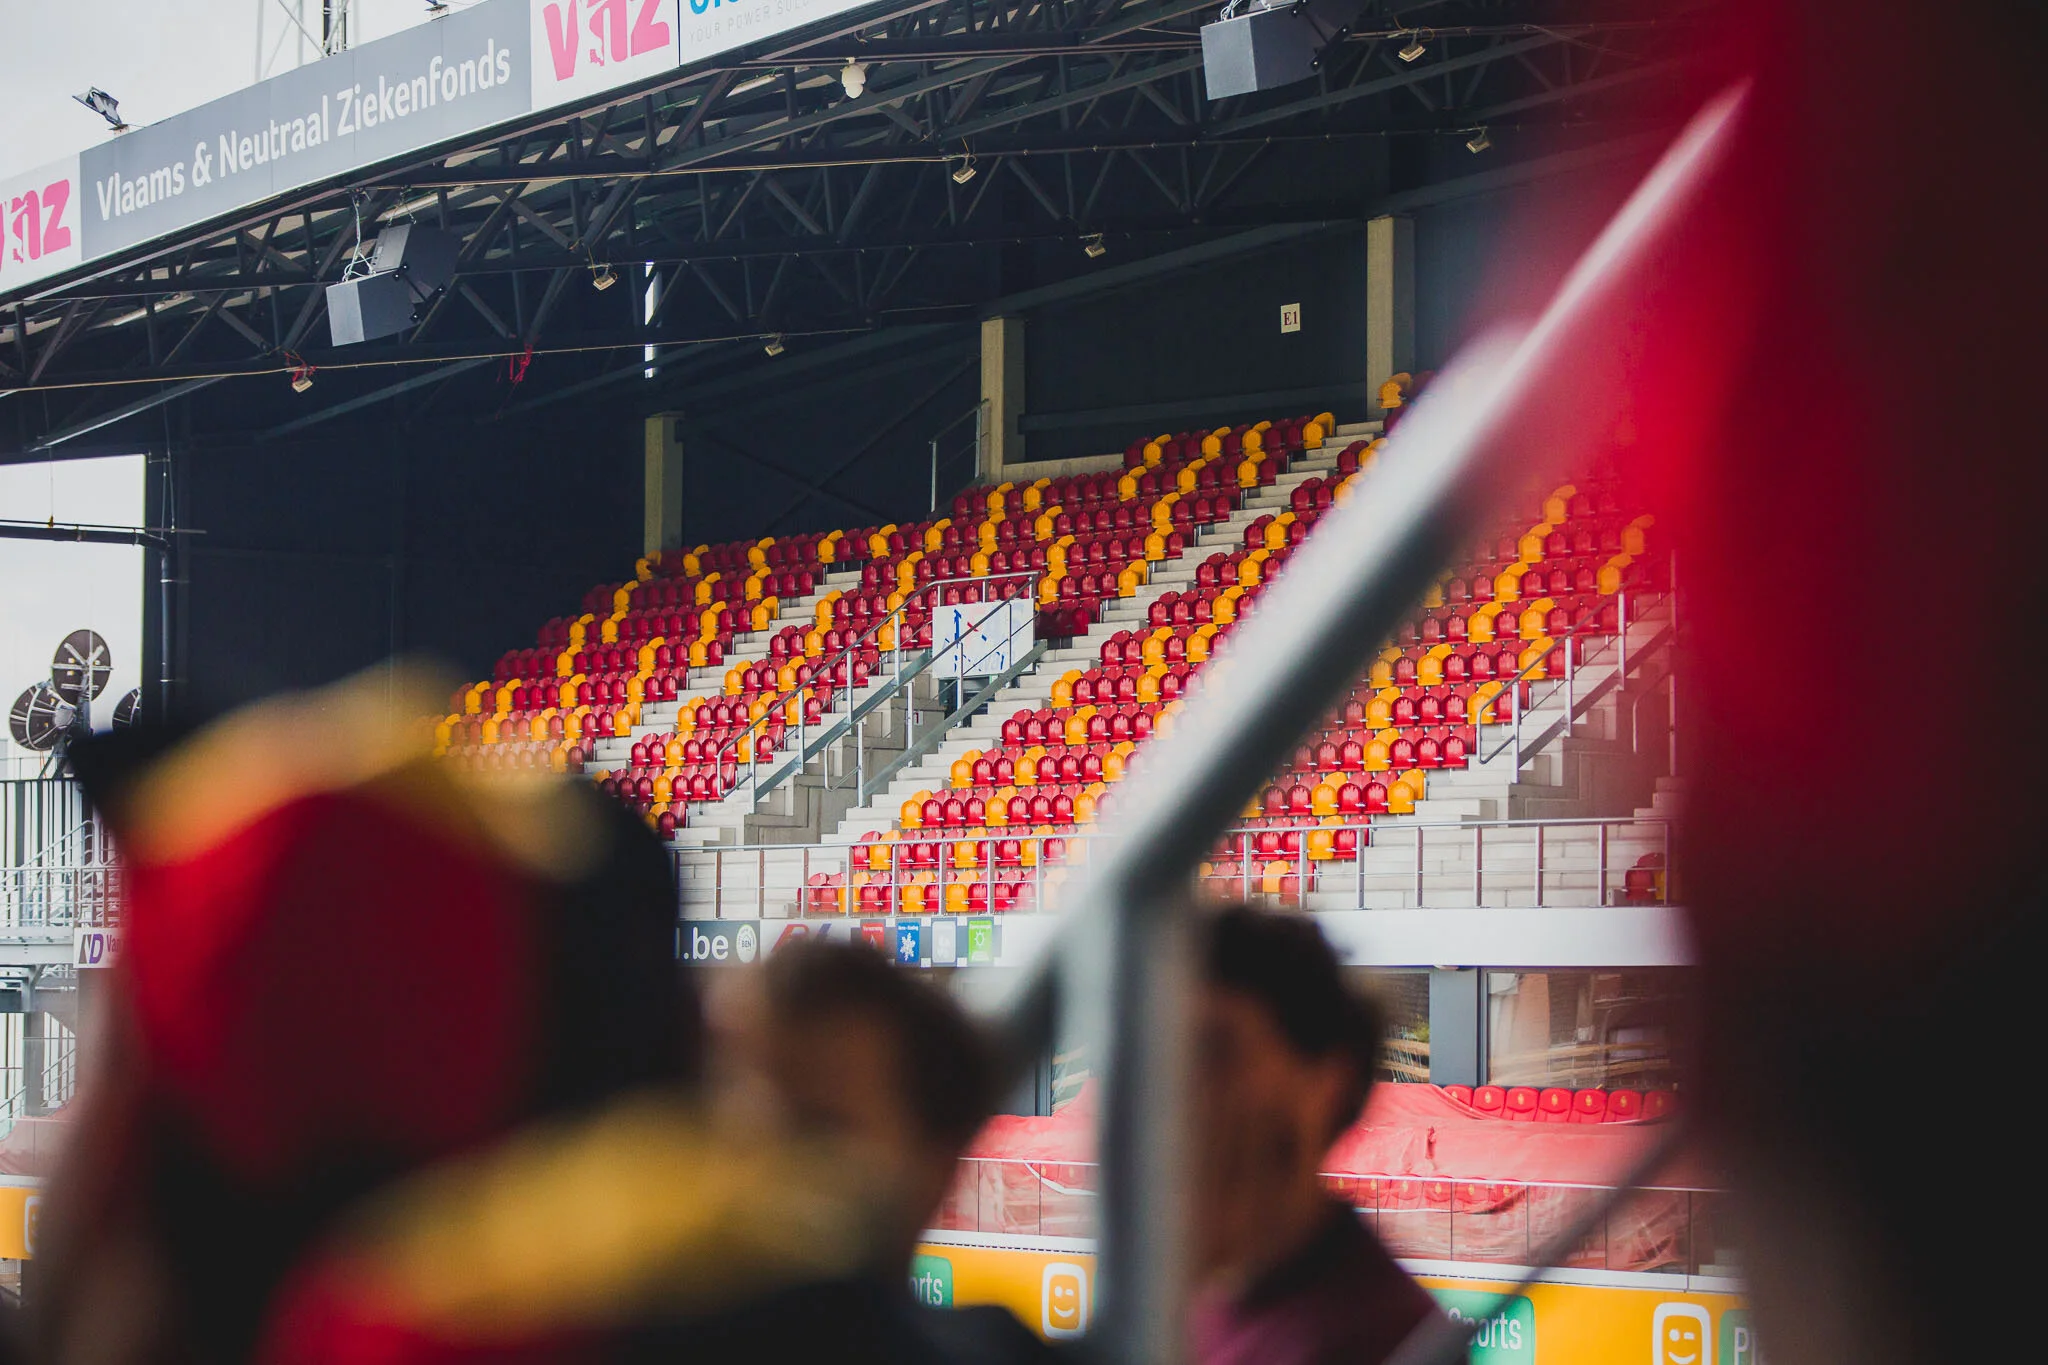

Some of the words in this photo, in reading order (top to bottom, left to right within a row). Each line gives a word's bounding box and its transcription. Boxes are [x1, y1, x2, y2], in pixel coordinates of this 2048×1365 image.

[689, 21, 721, 44] YOUR
[728, 5, 771, 32] POWER
[96, 161, 185, 221] Vlaams
[192, 141, 213, 187] &
[219, 94, 329, 178] Neutraal
[336, 37, 511, 137] Ziekenfonds
[1283, 311, 1298, 326] E1
